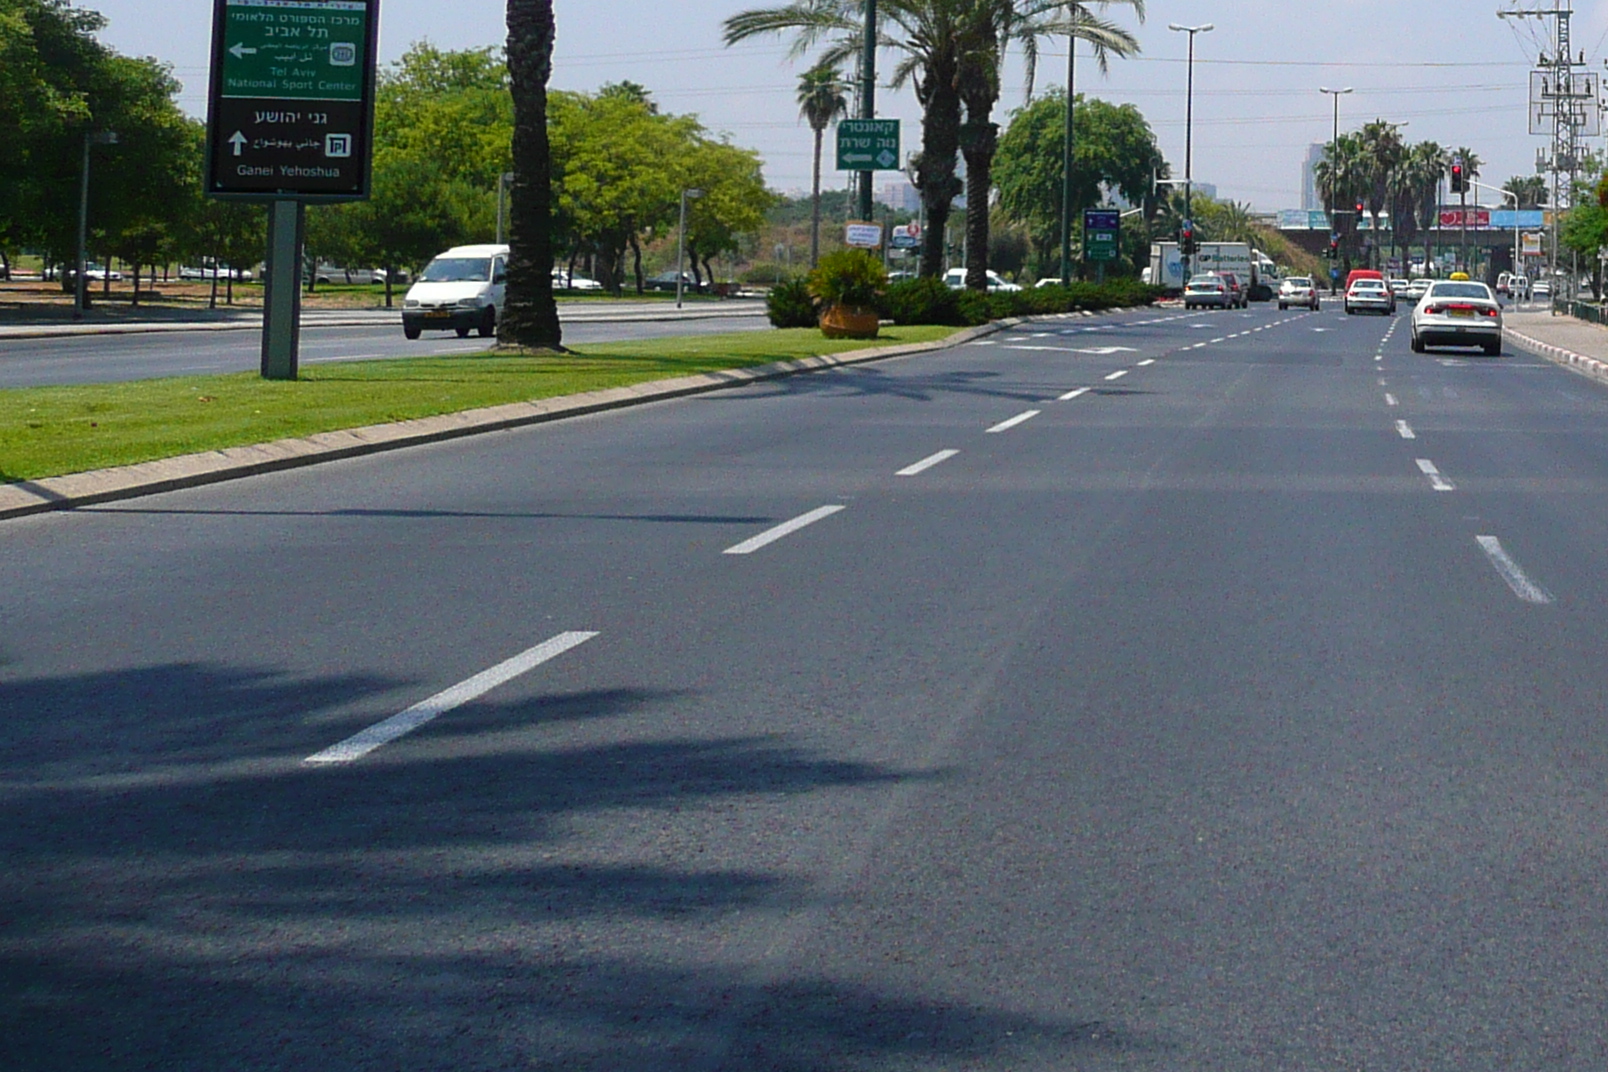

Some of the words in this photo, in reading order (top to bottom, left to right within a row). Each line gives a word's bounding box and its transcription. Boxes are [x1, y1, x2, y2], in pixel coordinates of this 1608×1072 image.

[231, 11, 274, 22] הלאומי
[279, 14, 326, 24] הספורט
[330, 16, 360, 26] מרכז
[265, 26, 301, 37] אביב
[307, 25, 328, 38] תל
[270, 66, 287, 77] Tel
[292, 67, 317, 77] Aviv
[228, 78, 276, 88] National
[282, 79, 313, 90] Sport
[318, 81, 356, 90] Center
[254, 110, 301, 124] יהושע
[308, 112, 327, 124] גני
[842, 122, 894, 135] קאונטרי
[840, 137, 871, 149] שרת
[876, 137, 896, 149] נוה
[237, 165, 273, 176] Ganei
[280, 165, 340, 177] Yehoshua
